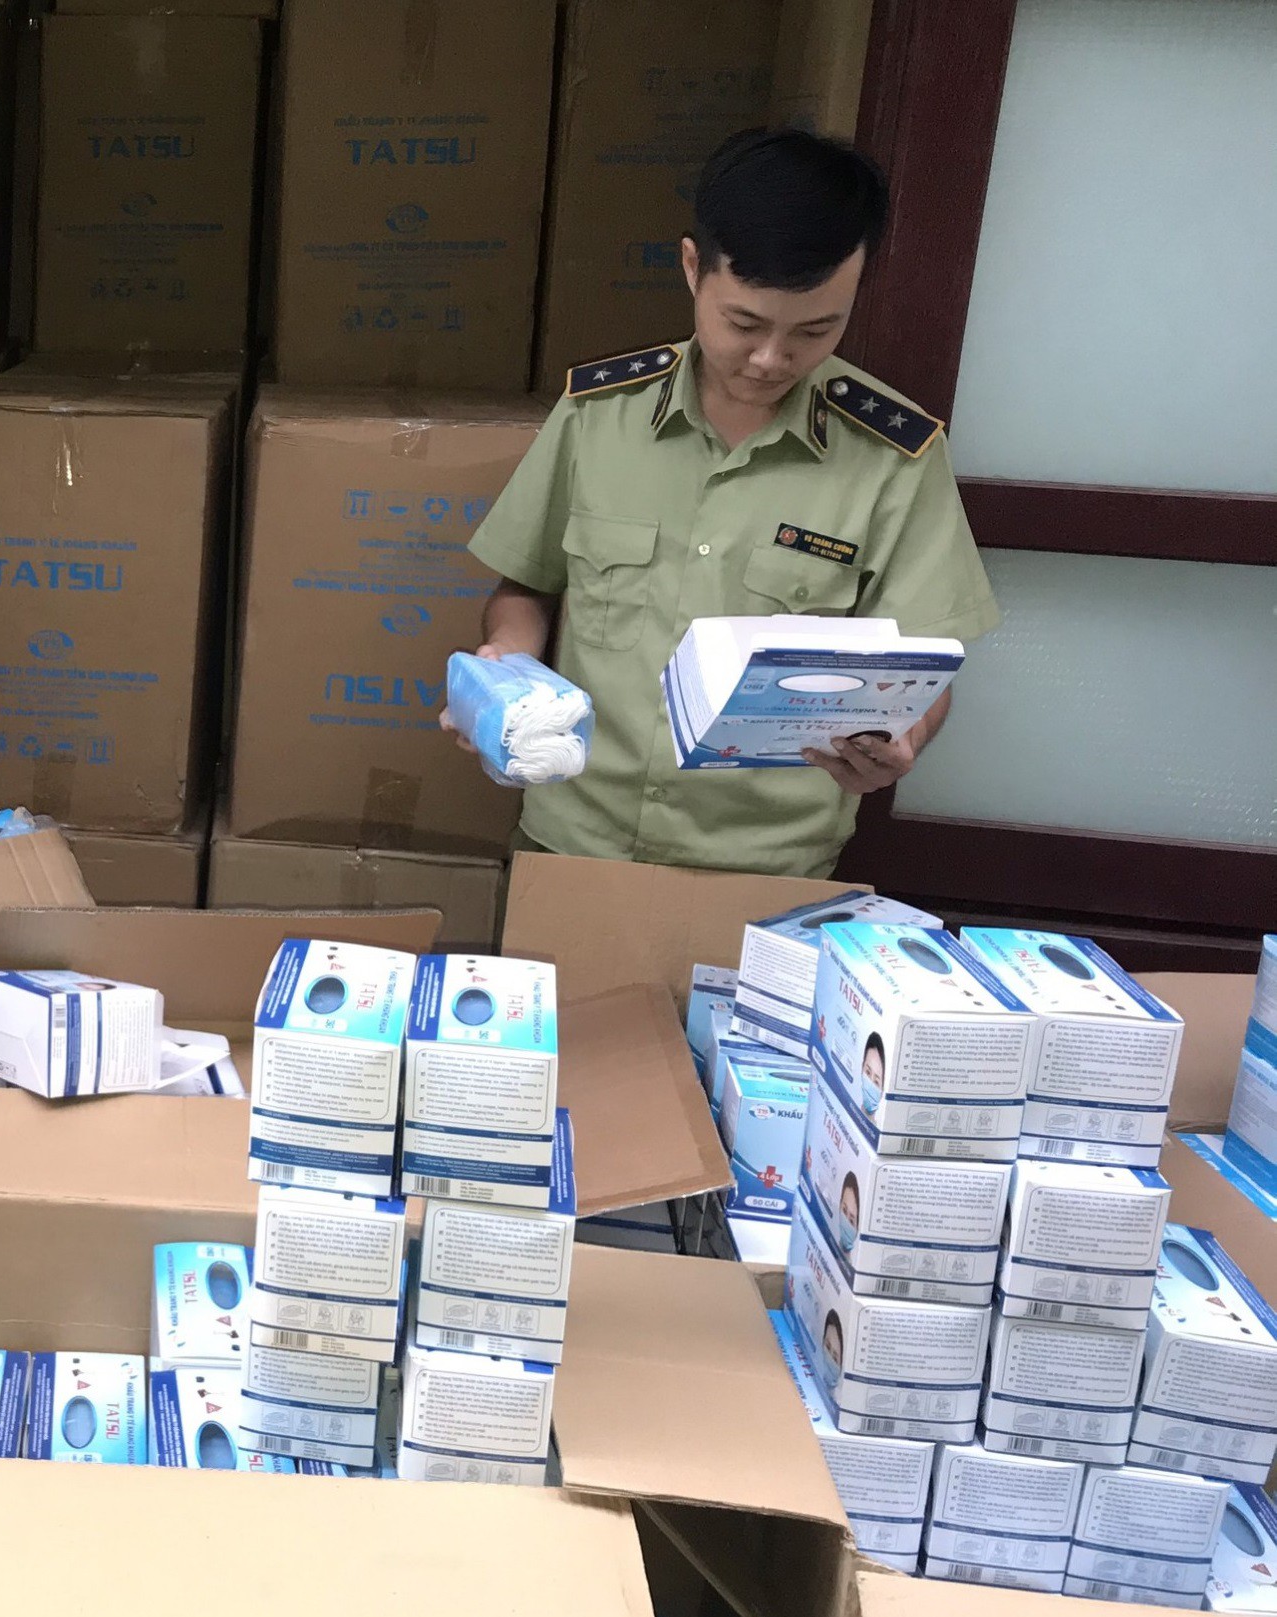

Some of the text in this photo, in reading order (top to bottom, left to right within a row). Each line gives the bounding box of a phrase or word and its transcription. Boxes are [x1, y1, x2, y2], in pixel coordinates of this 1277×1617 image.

[88, 134, 196, 160] TATSU
[345, 136, 476, 166] TATSU
[839, 975, 864, 1016] TATSU
[823, 1111, 843, 1154] TATSU
[753, 1198, 763, 1206] 50
[106, 1403, 120, 1440] TATSU
